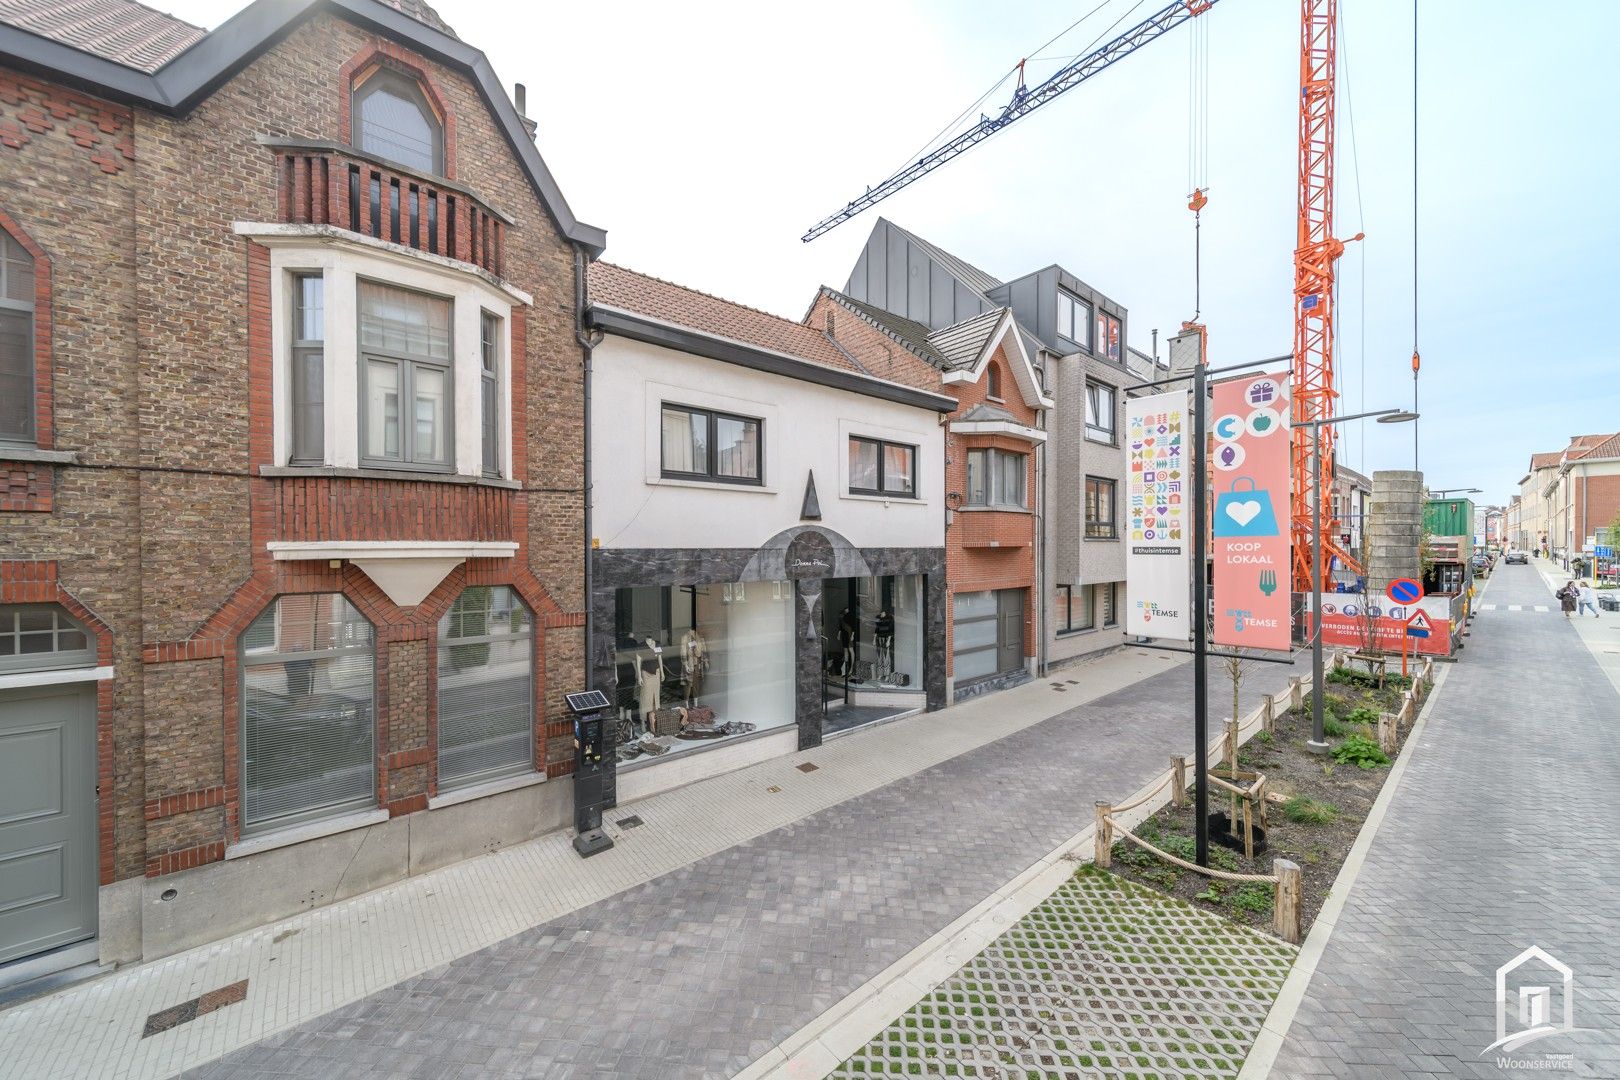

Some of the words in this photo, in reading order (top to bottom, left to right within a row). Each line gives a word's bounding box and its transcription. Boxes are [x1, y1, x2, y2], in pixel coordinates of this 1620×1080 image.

[1227, 542, 1261, 552] KOOP
[1227, 554, 1273, 565] LOKAAL
[1152, 609, 1179, 618] TEMSE
[1245, 617, 1278, 628] TEMSE
